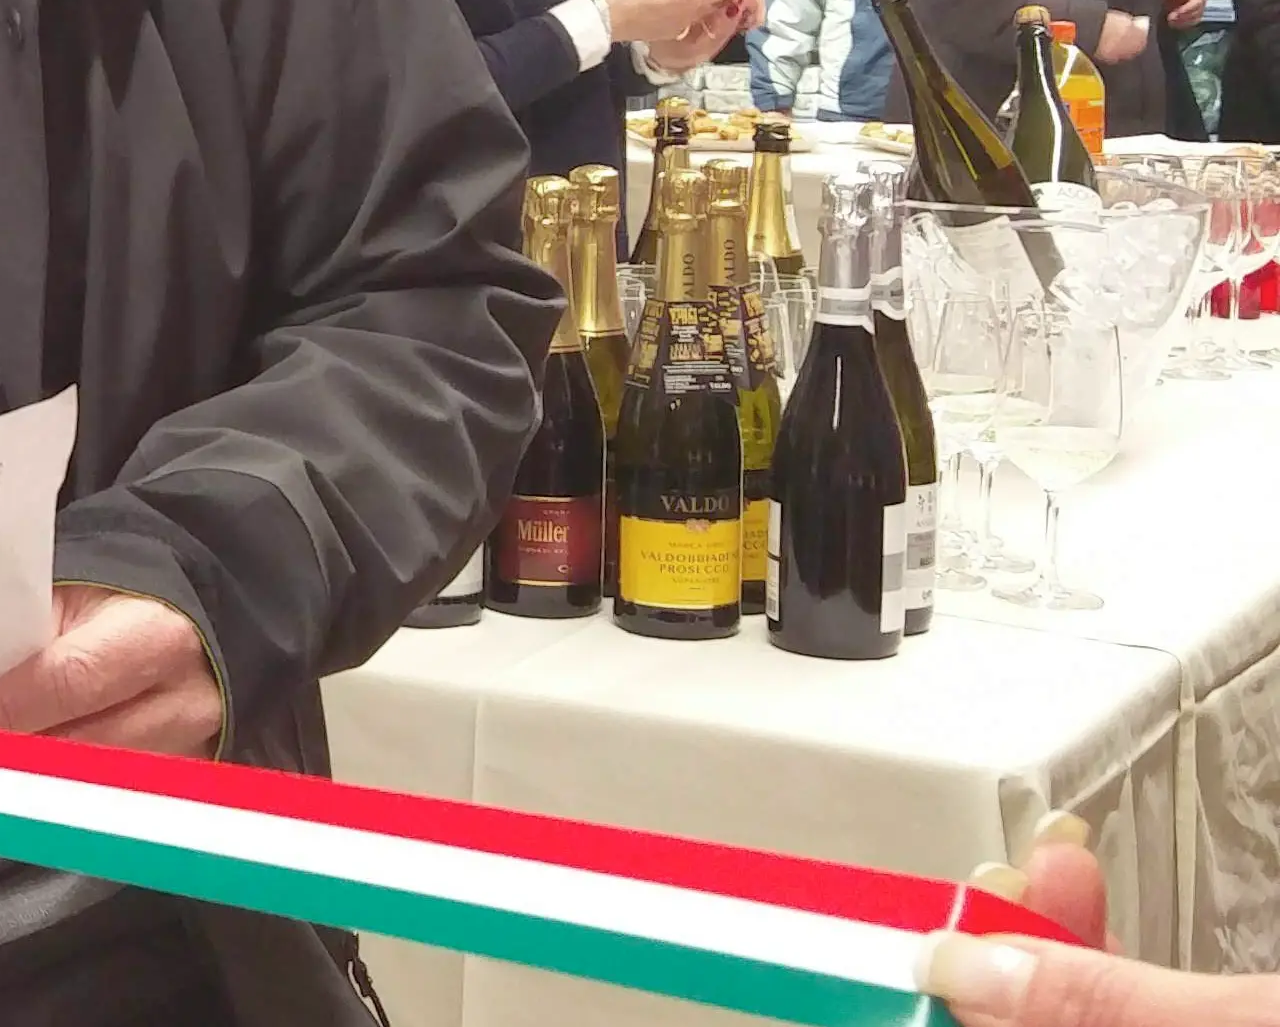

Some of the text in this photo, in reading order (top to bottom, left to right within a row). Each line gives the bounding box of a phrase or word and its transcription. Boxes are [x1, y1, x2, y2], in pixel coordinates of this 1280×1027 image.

[661, 494, 730, 514] VALDO
[518, 519, 571, 543] Müller
[660, 563, 729, 574] PROSECCO
